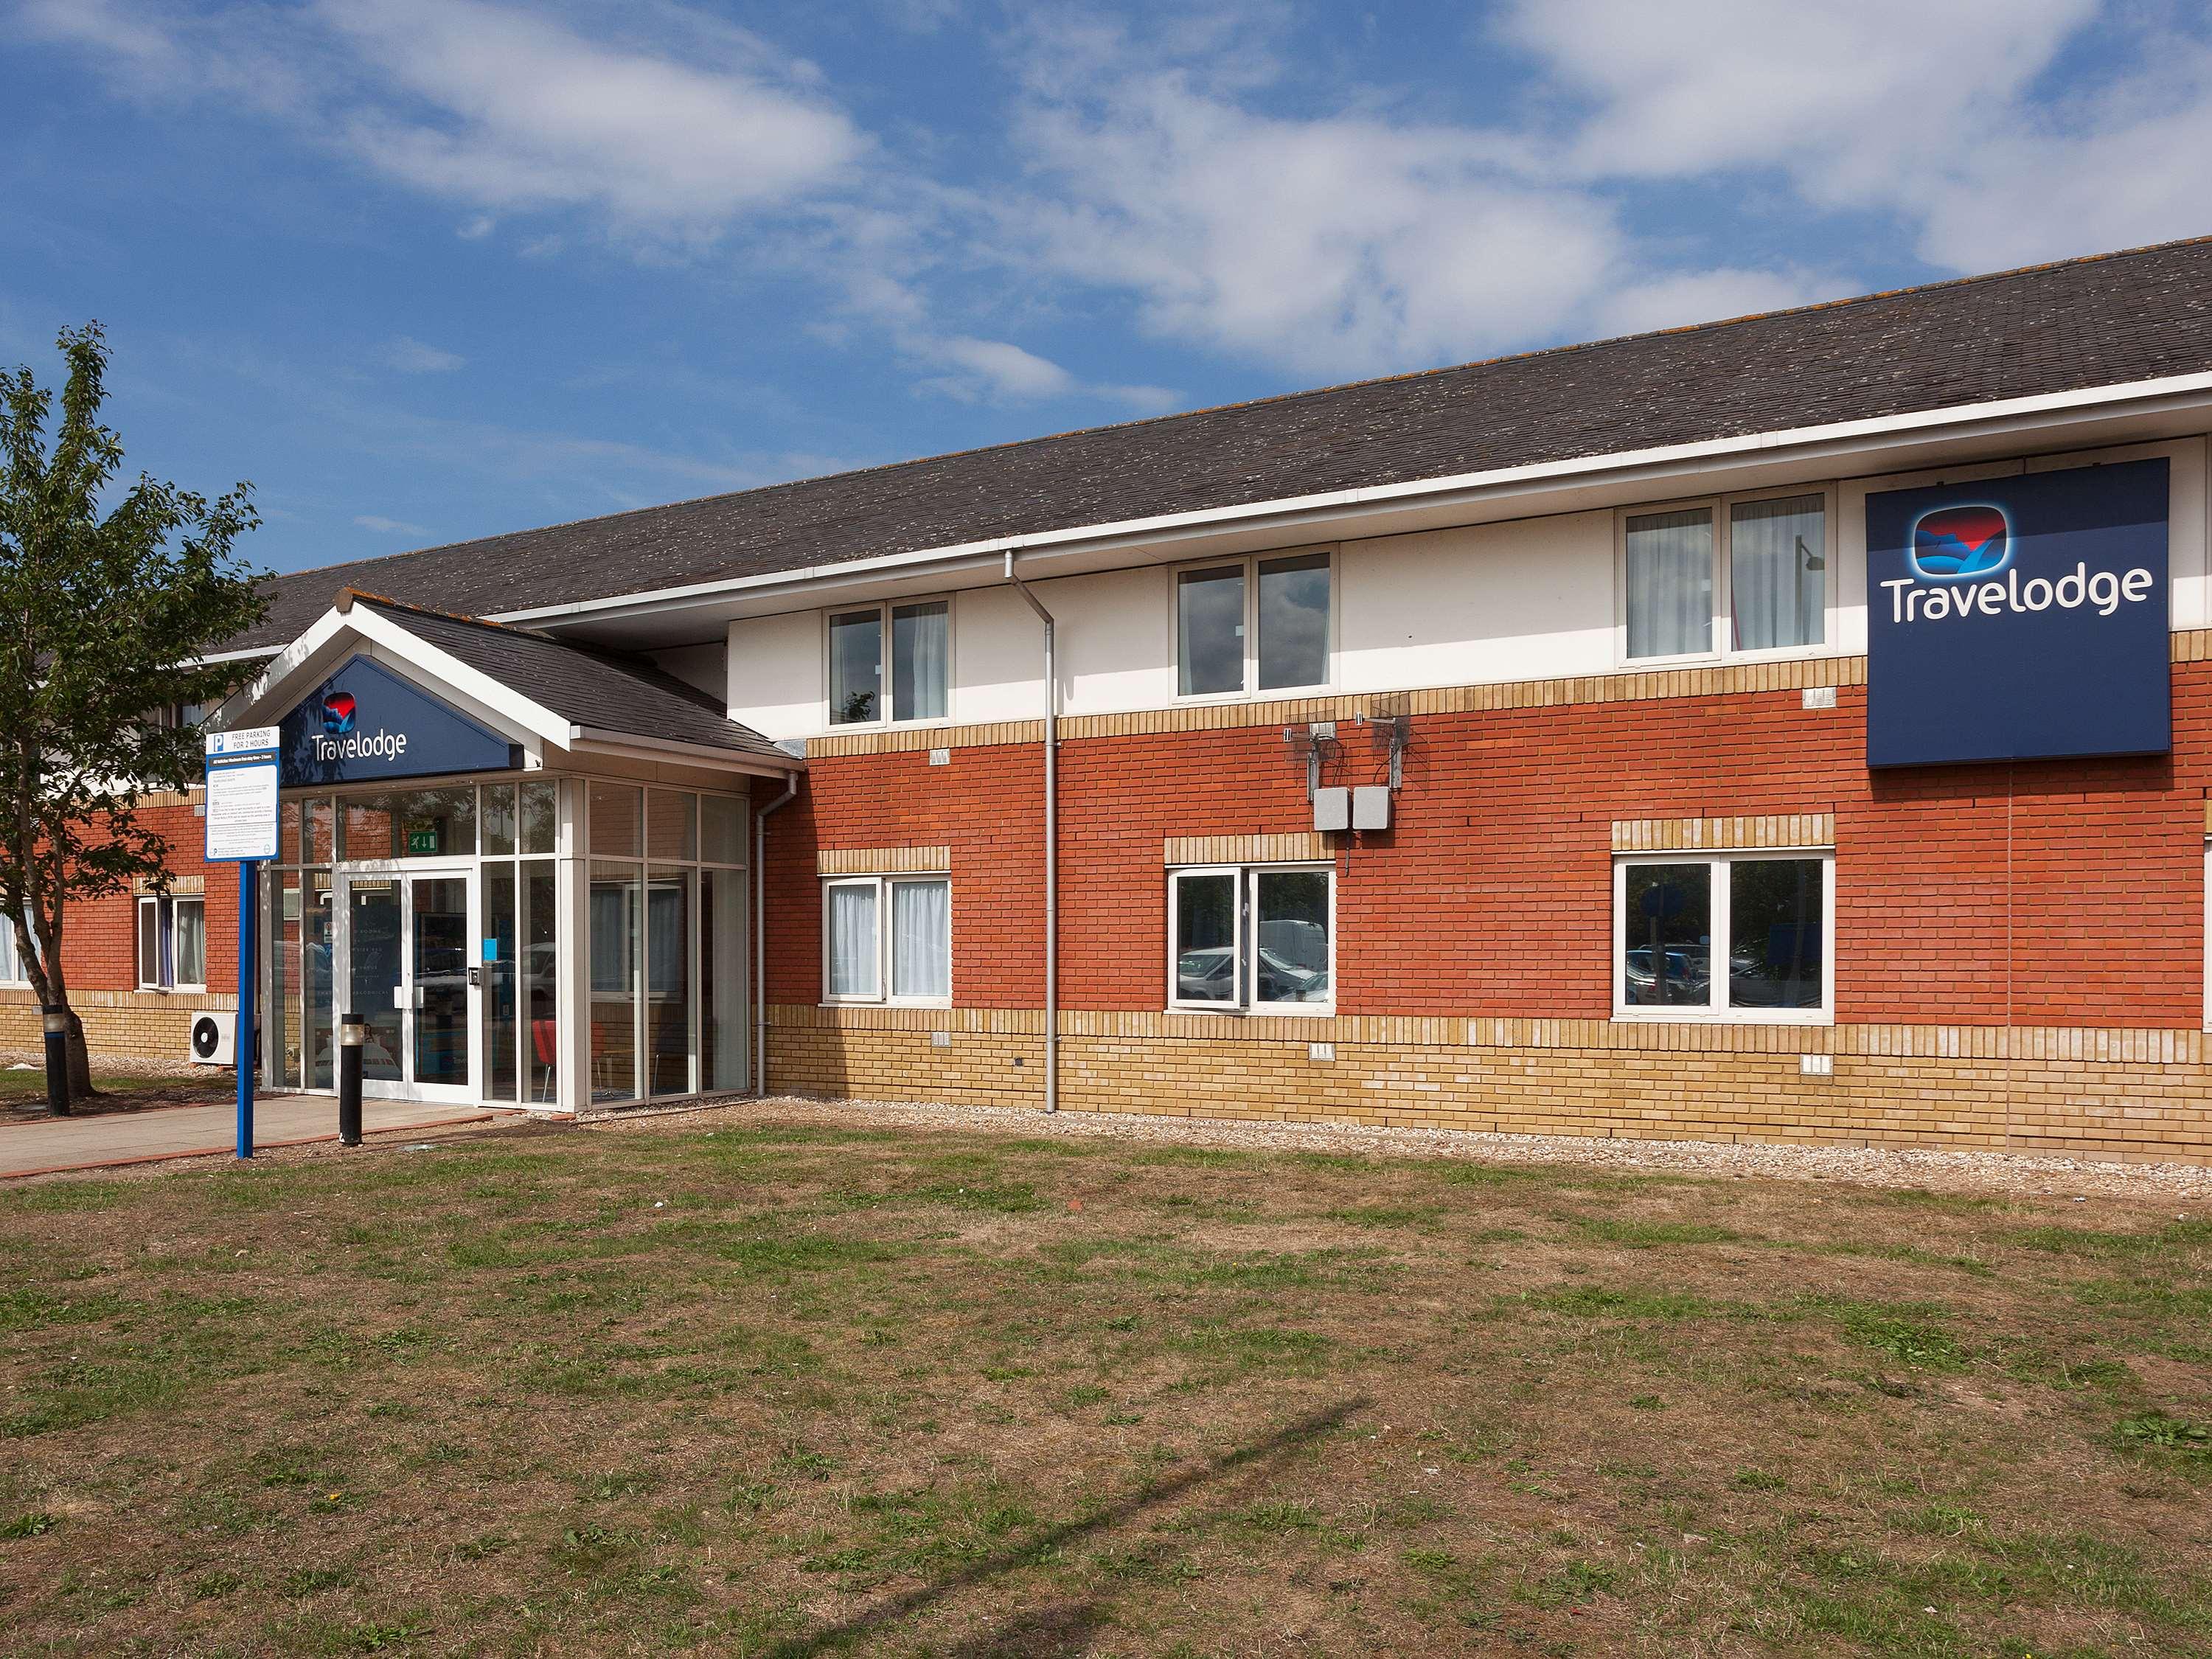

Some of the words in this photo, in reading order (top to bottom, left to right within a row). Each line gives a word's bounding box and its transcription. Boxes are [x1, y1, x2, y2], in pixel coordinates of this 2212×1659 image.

[1880, 561, 2153, 623] Travelodge
[232, 732, 245, 740] FREE
[246, 730, 271, 738] PARKING
[234, 741, 244, 749] FOR
[250, 739, 269, 747] HOURS
[311, 728, 407, 762] Travelodge
